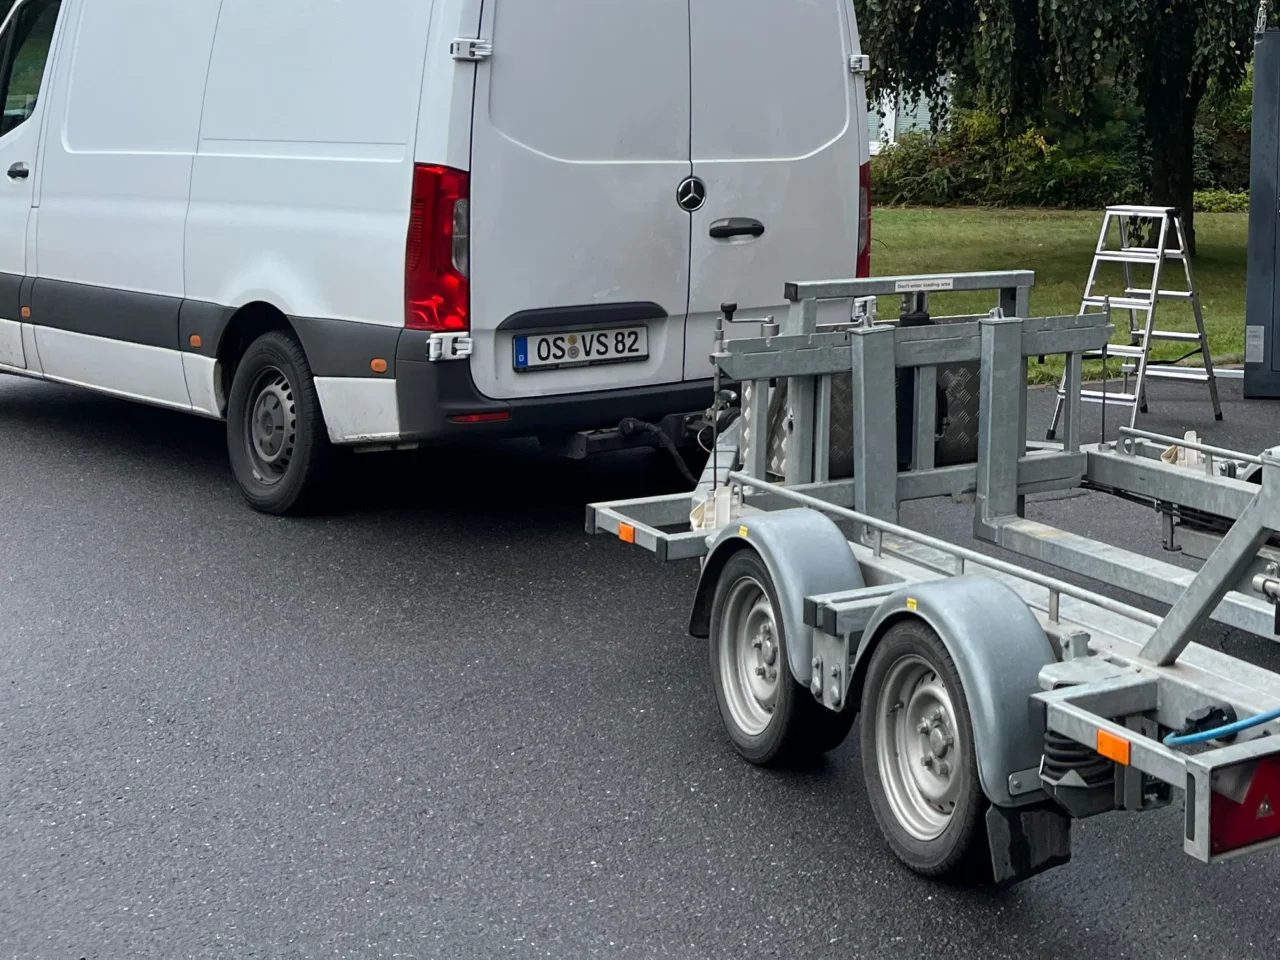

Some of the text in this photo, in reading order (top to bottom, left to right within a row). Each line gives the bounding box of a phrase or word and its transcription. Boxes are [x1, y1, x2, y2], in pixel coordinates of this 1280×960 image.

[537, 331, 640, 362] OS VS 82
[518, 354, 525, 362] D
